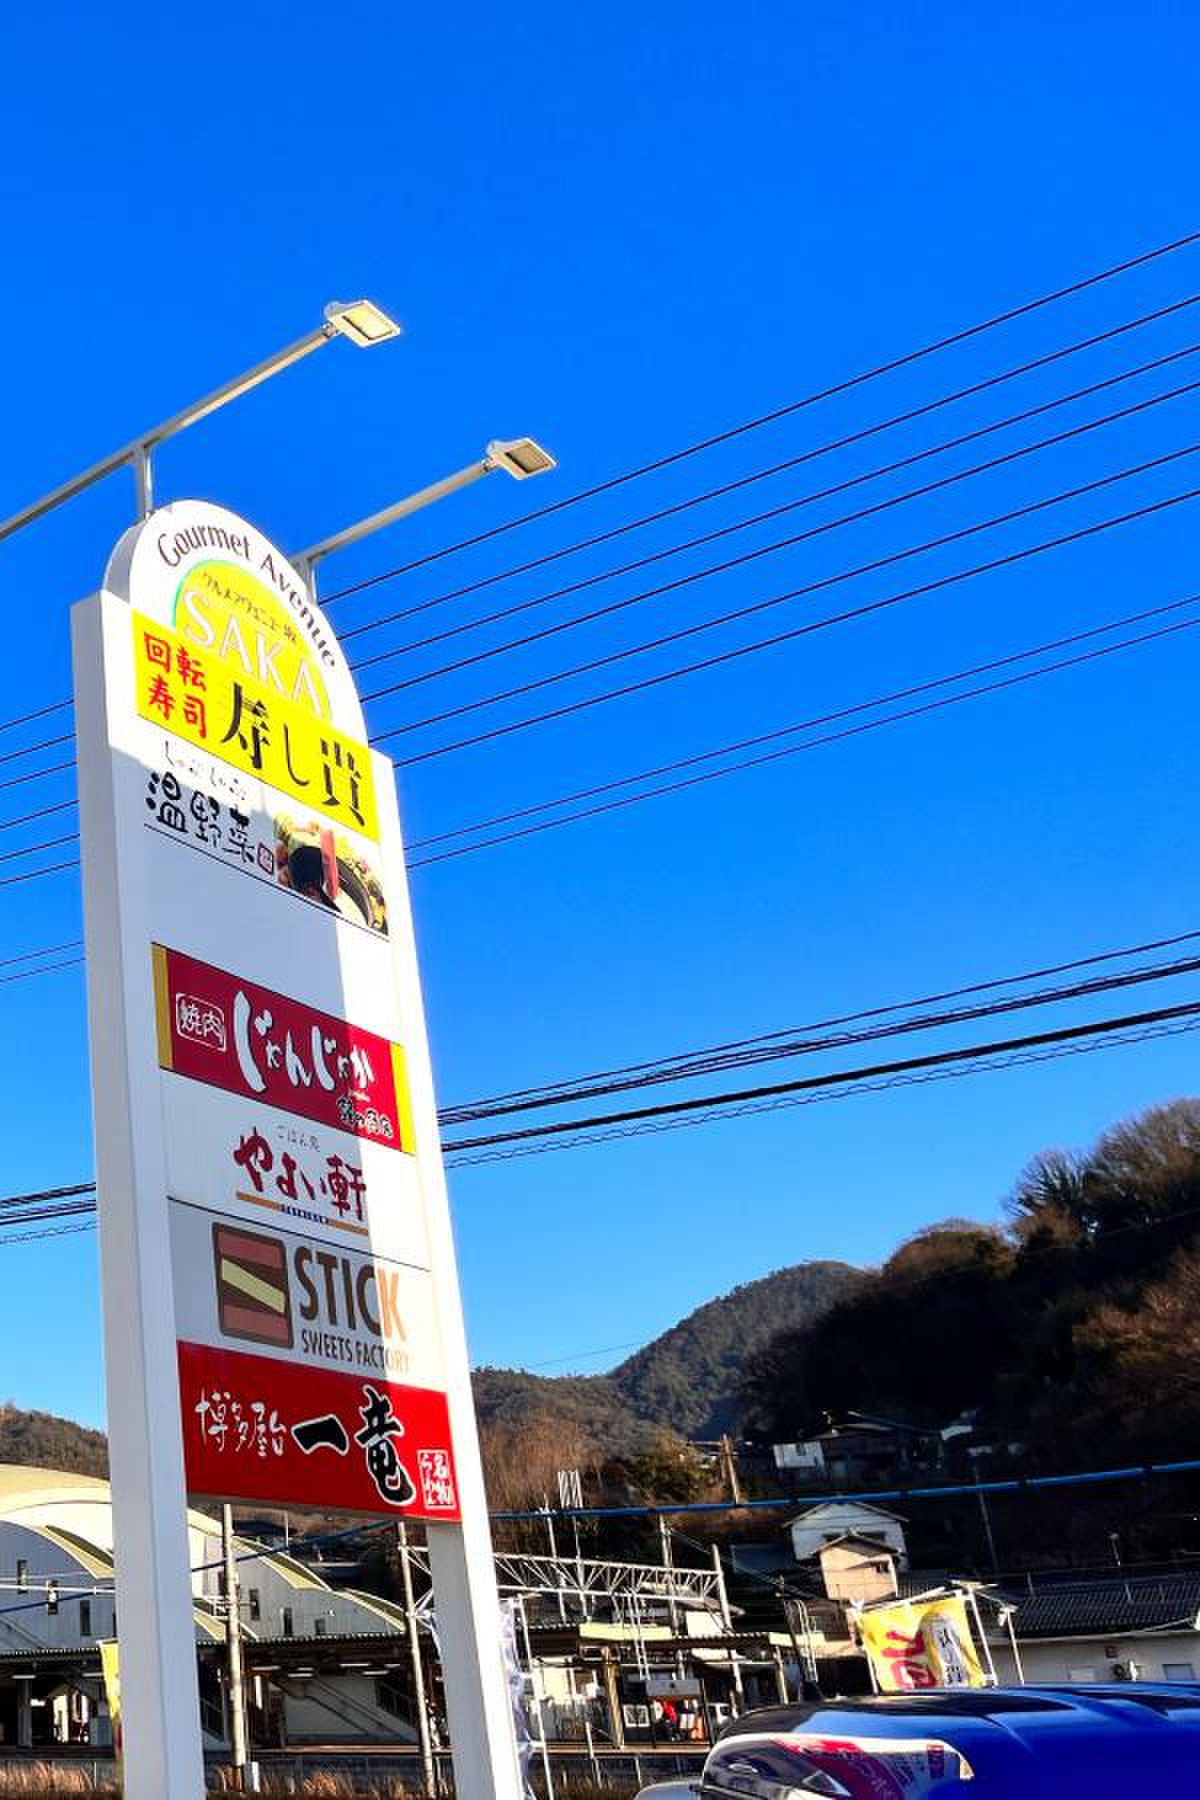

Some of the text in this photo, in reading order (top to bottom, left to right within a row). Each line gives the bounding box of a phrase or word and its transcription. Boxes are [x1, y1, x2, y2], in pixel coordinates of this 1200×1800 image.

[157, 523, 336, 668] Gourmet Avenue
[143, 631, 207, 692] 回転
[183, 590, 323, 718] SAKA
[147, 673, 207, 740] 寿司
[145, 770, 256, 864] 温野菜
[180, 999, 224, 1046] 焼肉
[233, 990, 375, 1093] じゃんじゃか
[233, 1126, 368, 1221] やよい軒
[294, 1246, 407, 1342] STICK
[301, 1329, 353, 1362] SWEETS
